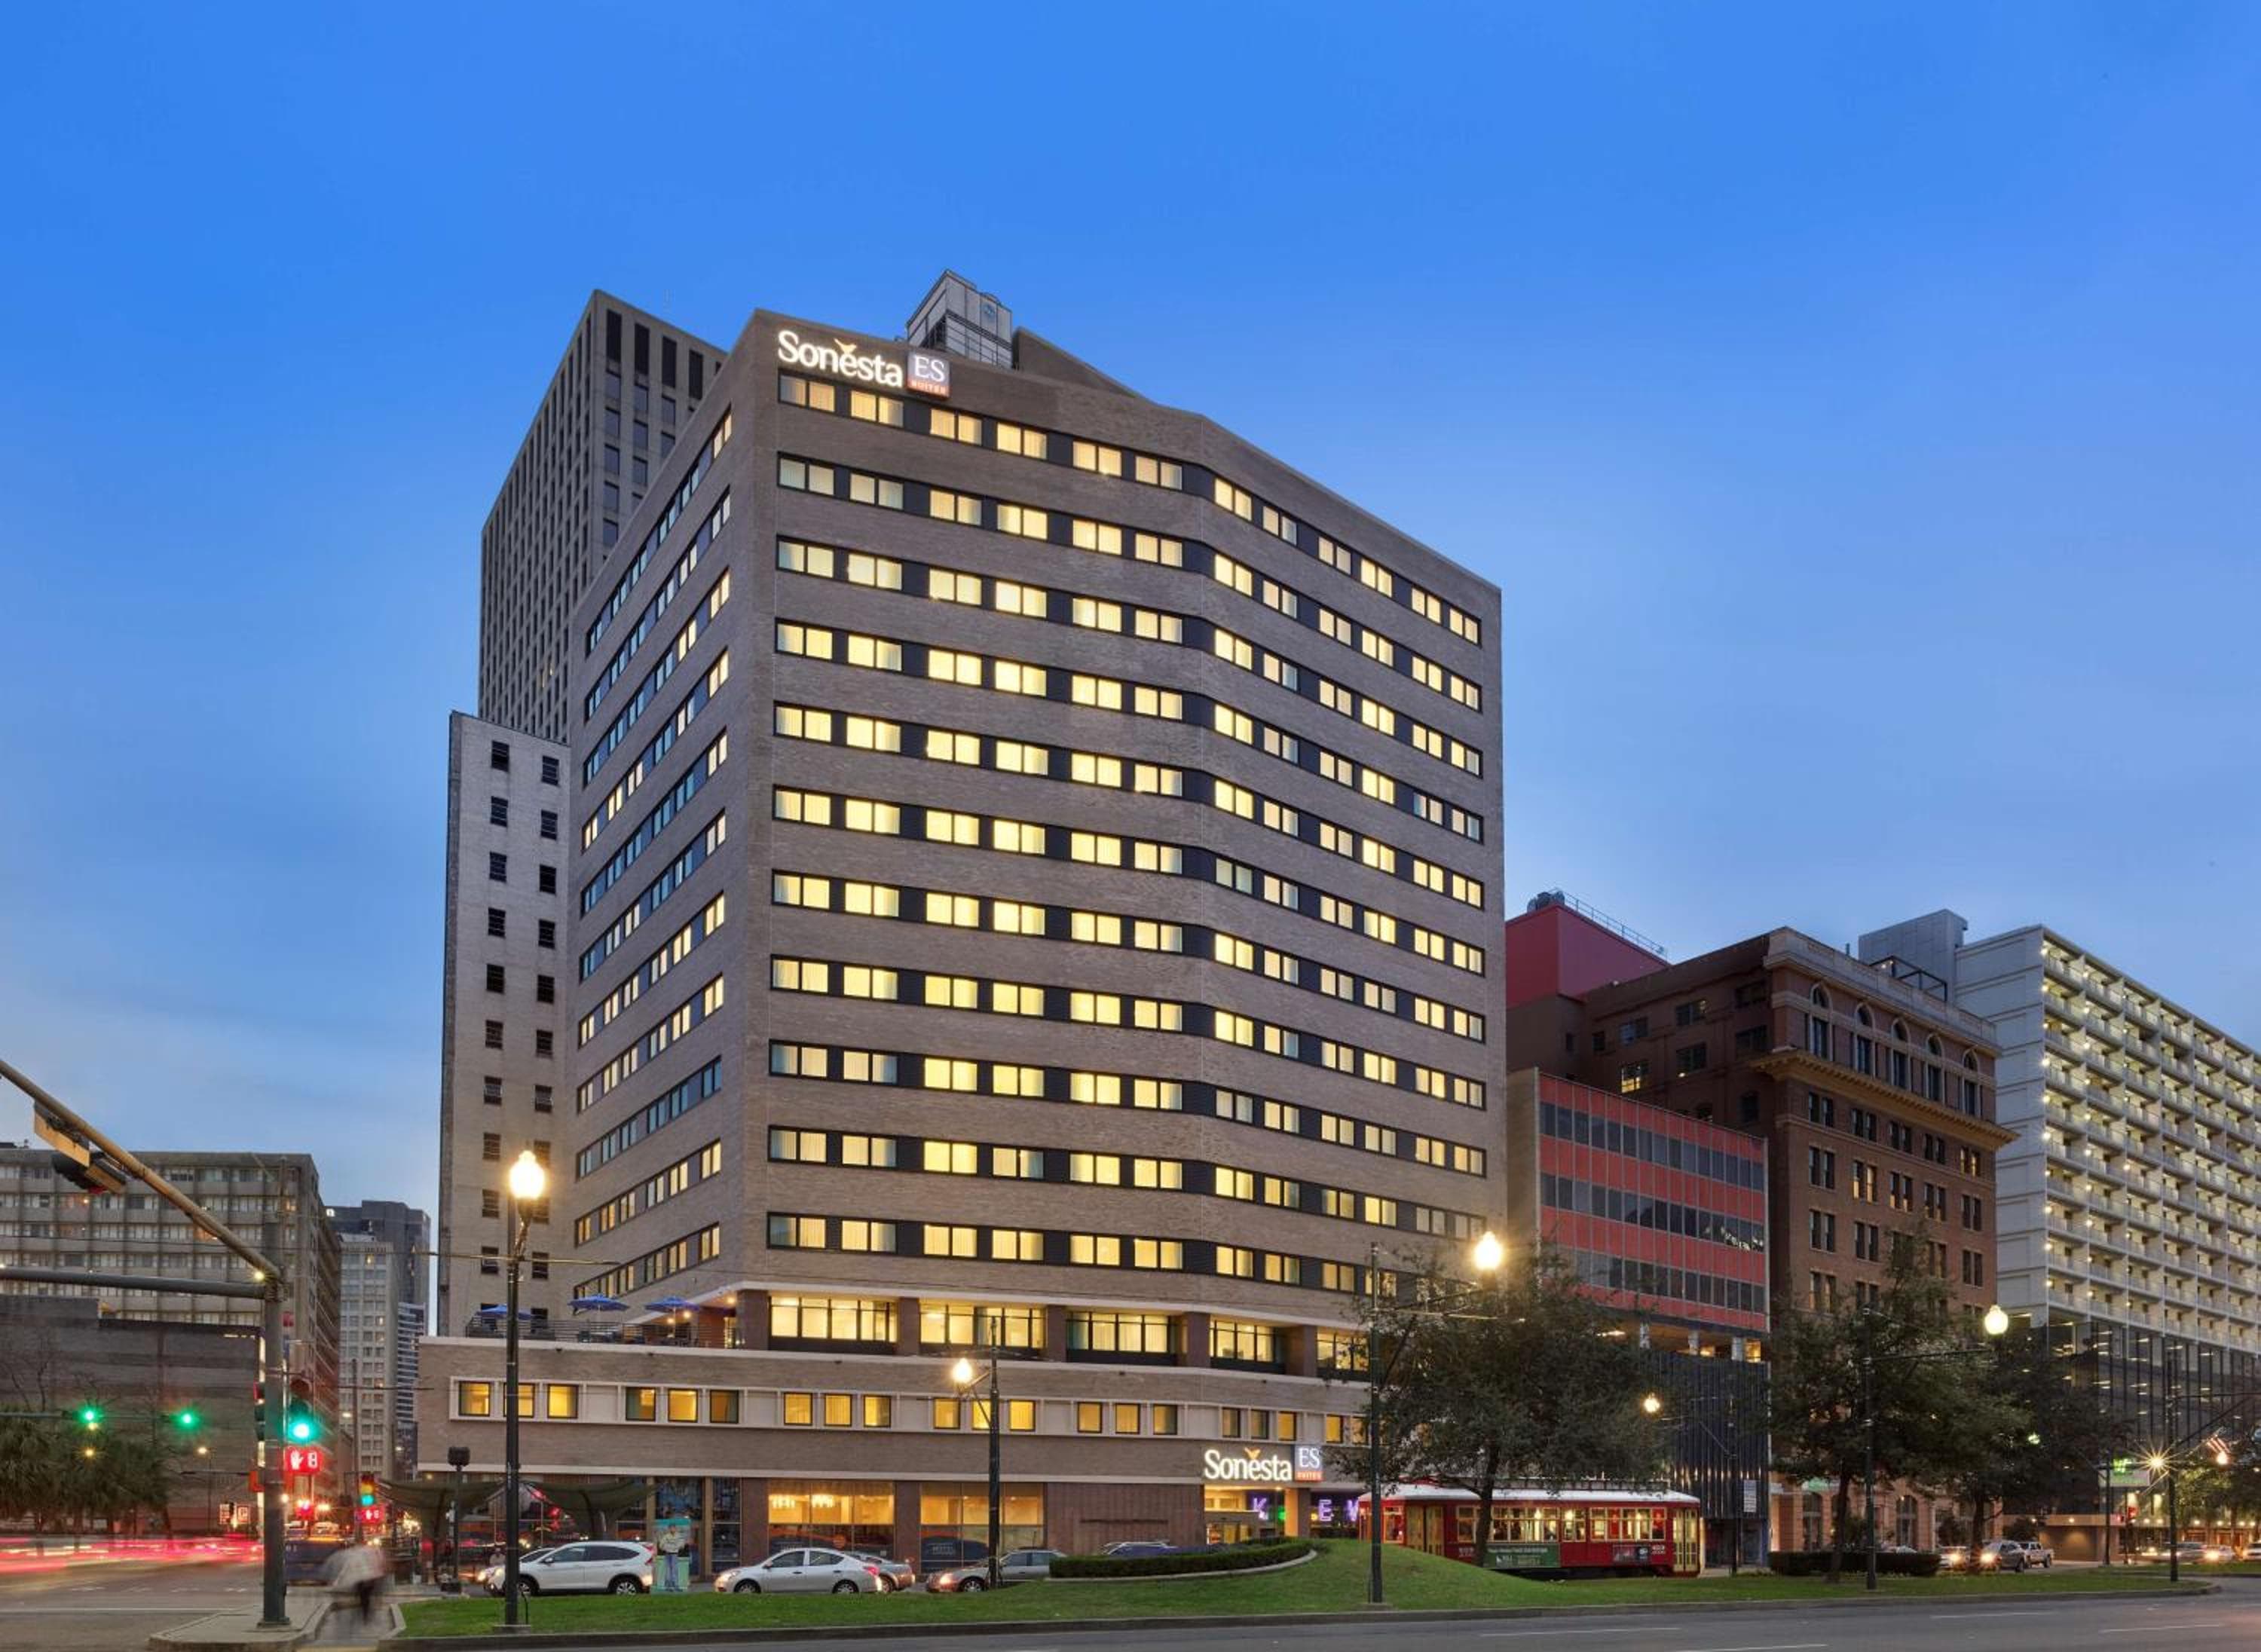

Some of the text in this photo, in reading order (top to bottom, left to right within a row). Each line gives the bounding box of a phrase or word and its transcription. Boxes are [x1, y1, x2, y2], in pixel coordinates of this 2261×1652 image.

[778, 330, 944, 388] Sonesta ES
[1204, 1448, 1320, 1481] Sonesta ES
